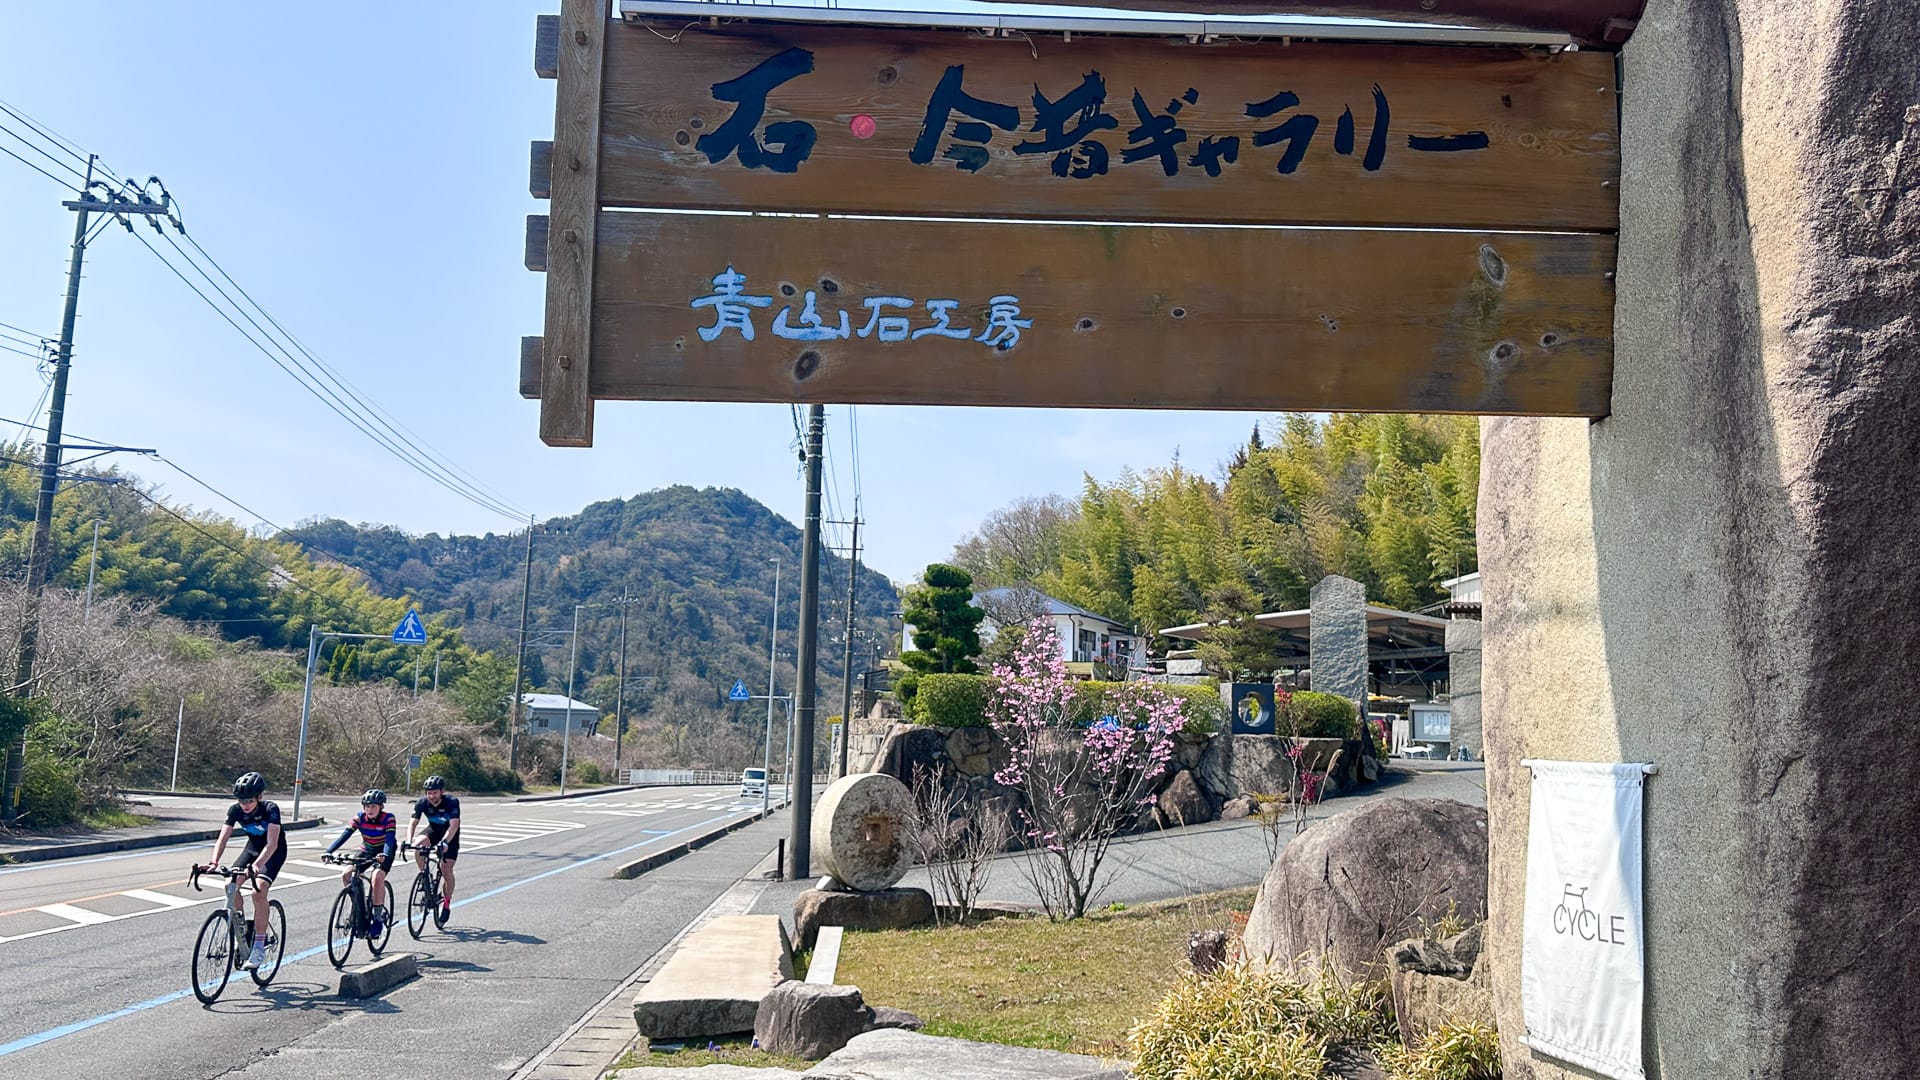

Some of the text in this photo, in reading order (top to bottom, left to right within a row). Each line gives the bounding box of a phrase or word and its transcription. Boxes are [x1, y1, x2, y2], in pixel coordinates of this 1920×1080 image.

[690, 265, 1033, 350] 青山石工房
[1553, 903, 1625, 945] CYCLE
